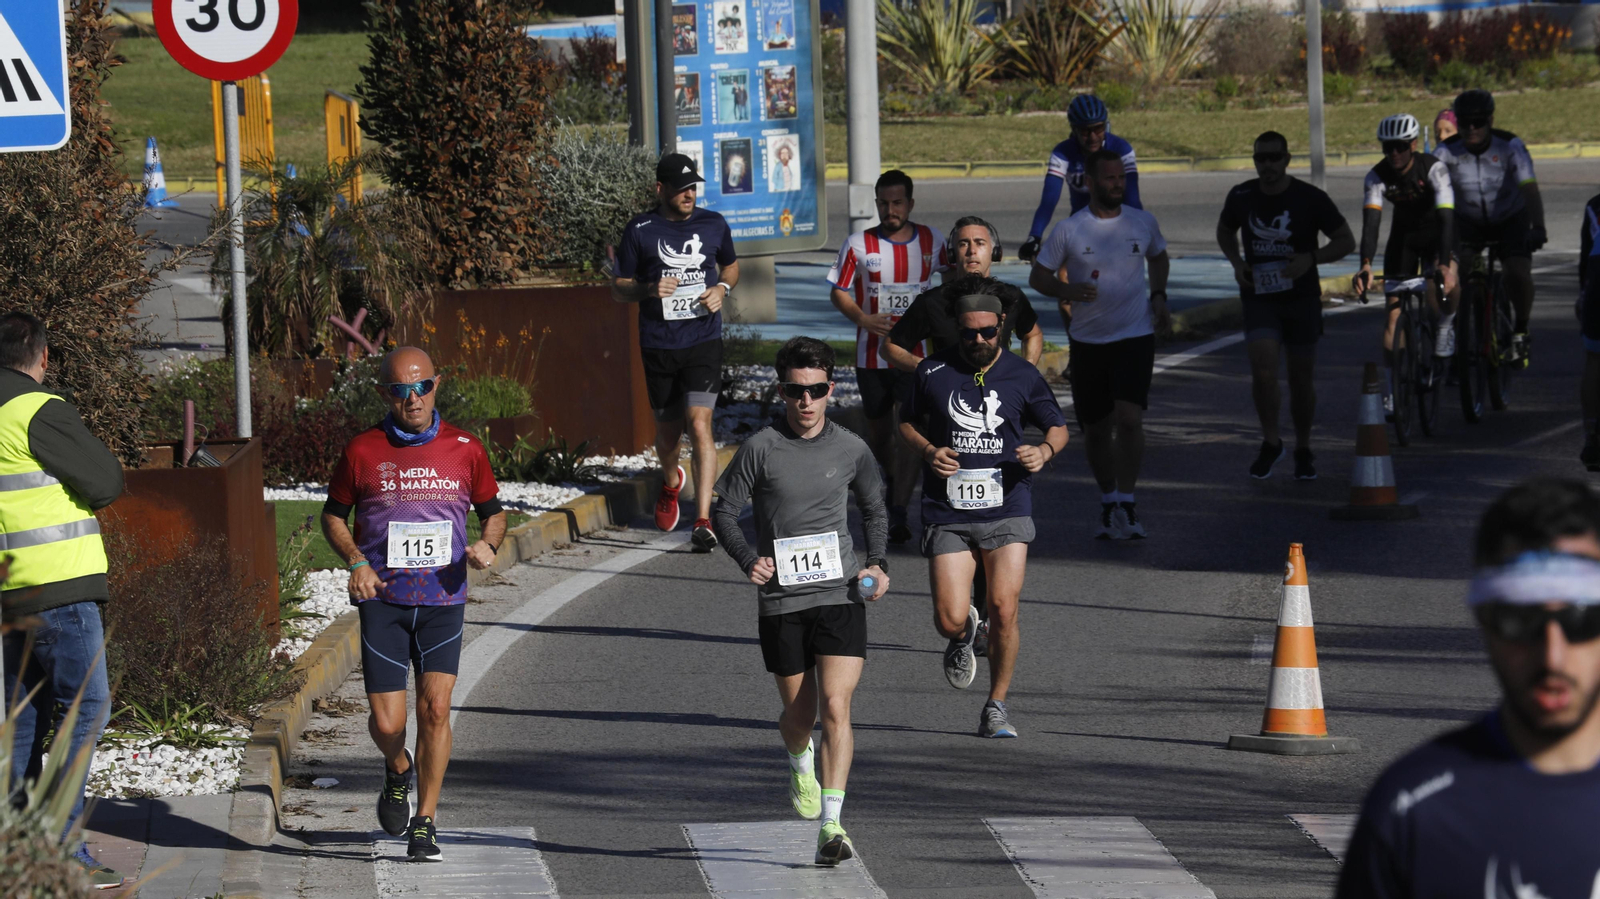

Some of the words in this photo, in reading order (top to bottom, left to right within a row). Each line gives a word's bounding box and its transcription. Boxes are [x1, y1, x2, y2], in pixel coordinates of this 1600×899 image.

[185, 0, 266, 33] 30
[1260, 273, 1279, 285] 231
[672, 298, 694, 312] 227
[887, 295, 909, 308] 128
[952, 436, 1004, 449] MARATÓN
[399, 467, 438, 479] MEDIA
[380, 479, 396, 491] 36
[400, 476, 460, 491] MARATÓN
[957, 484, 985, 499] 119
[402, 539, 434, 557] 115
[790, 551, 823, 573] 114
[796, 573, 828, 583] EVOS
